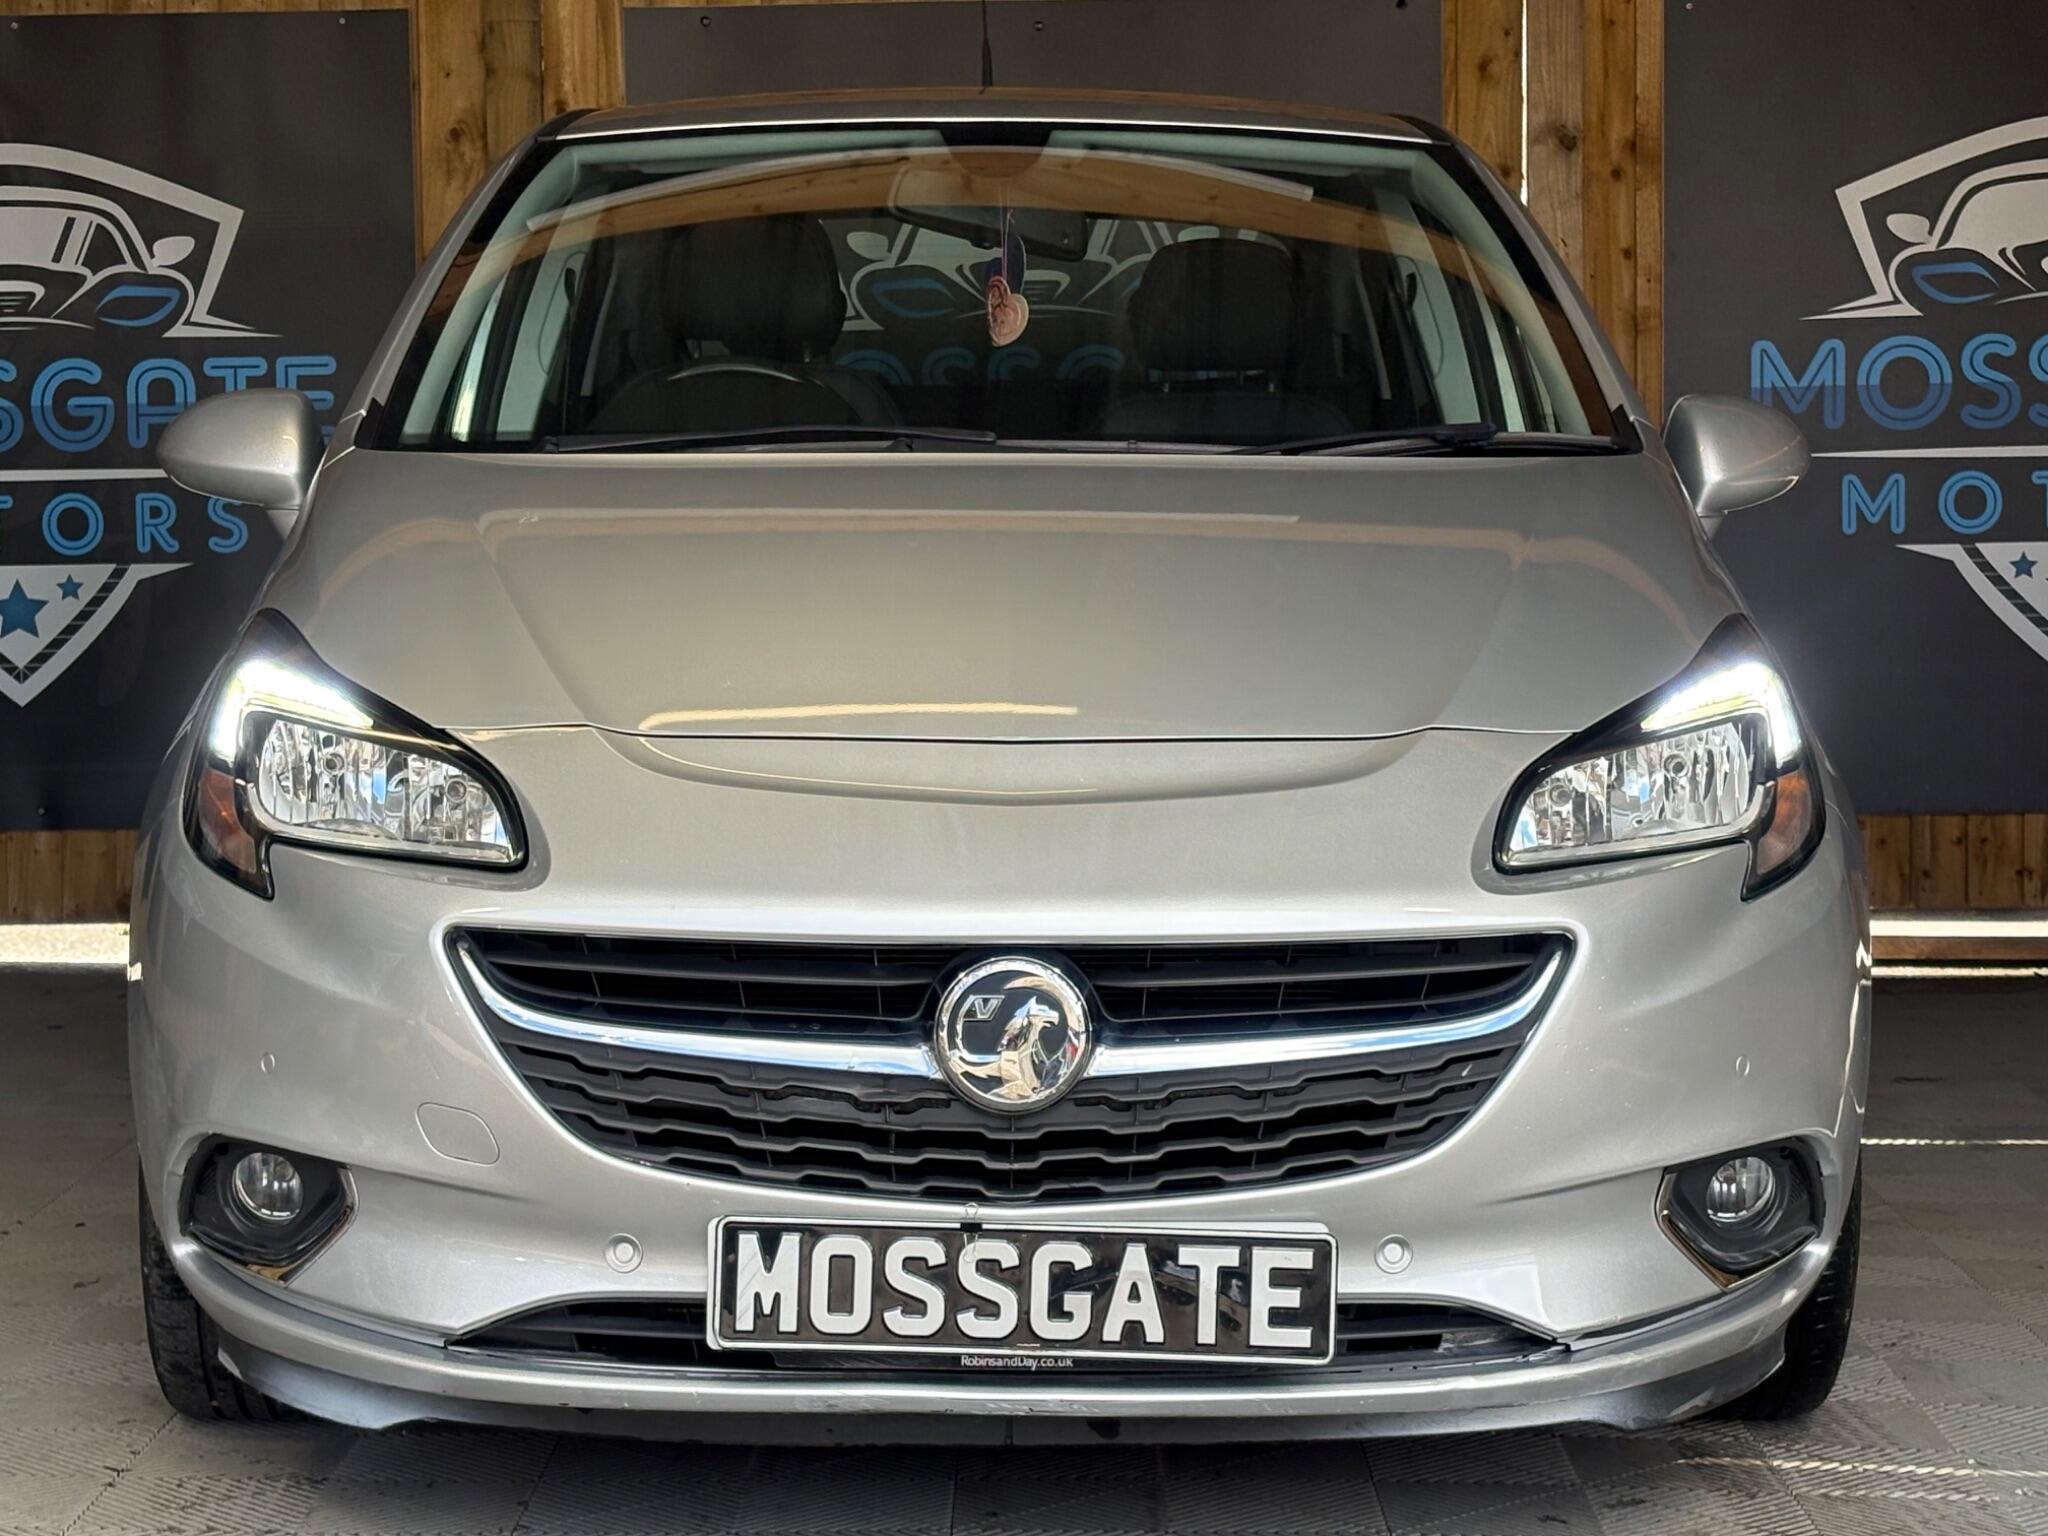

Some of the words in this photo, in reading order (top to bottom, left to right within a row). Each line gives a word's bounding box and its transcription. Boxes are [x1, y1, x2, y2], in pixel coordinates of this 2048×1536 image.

[0, 492, 249, 556] ORS
[735, 1231, 1315, 1349] MOSSGATE
[960, 1354, 1074, 1371] RobinsandDay.co.uk
